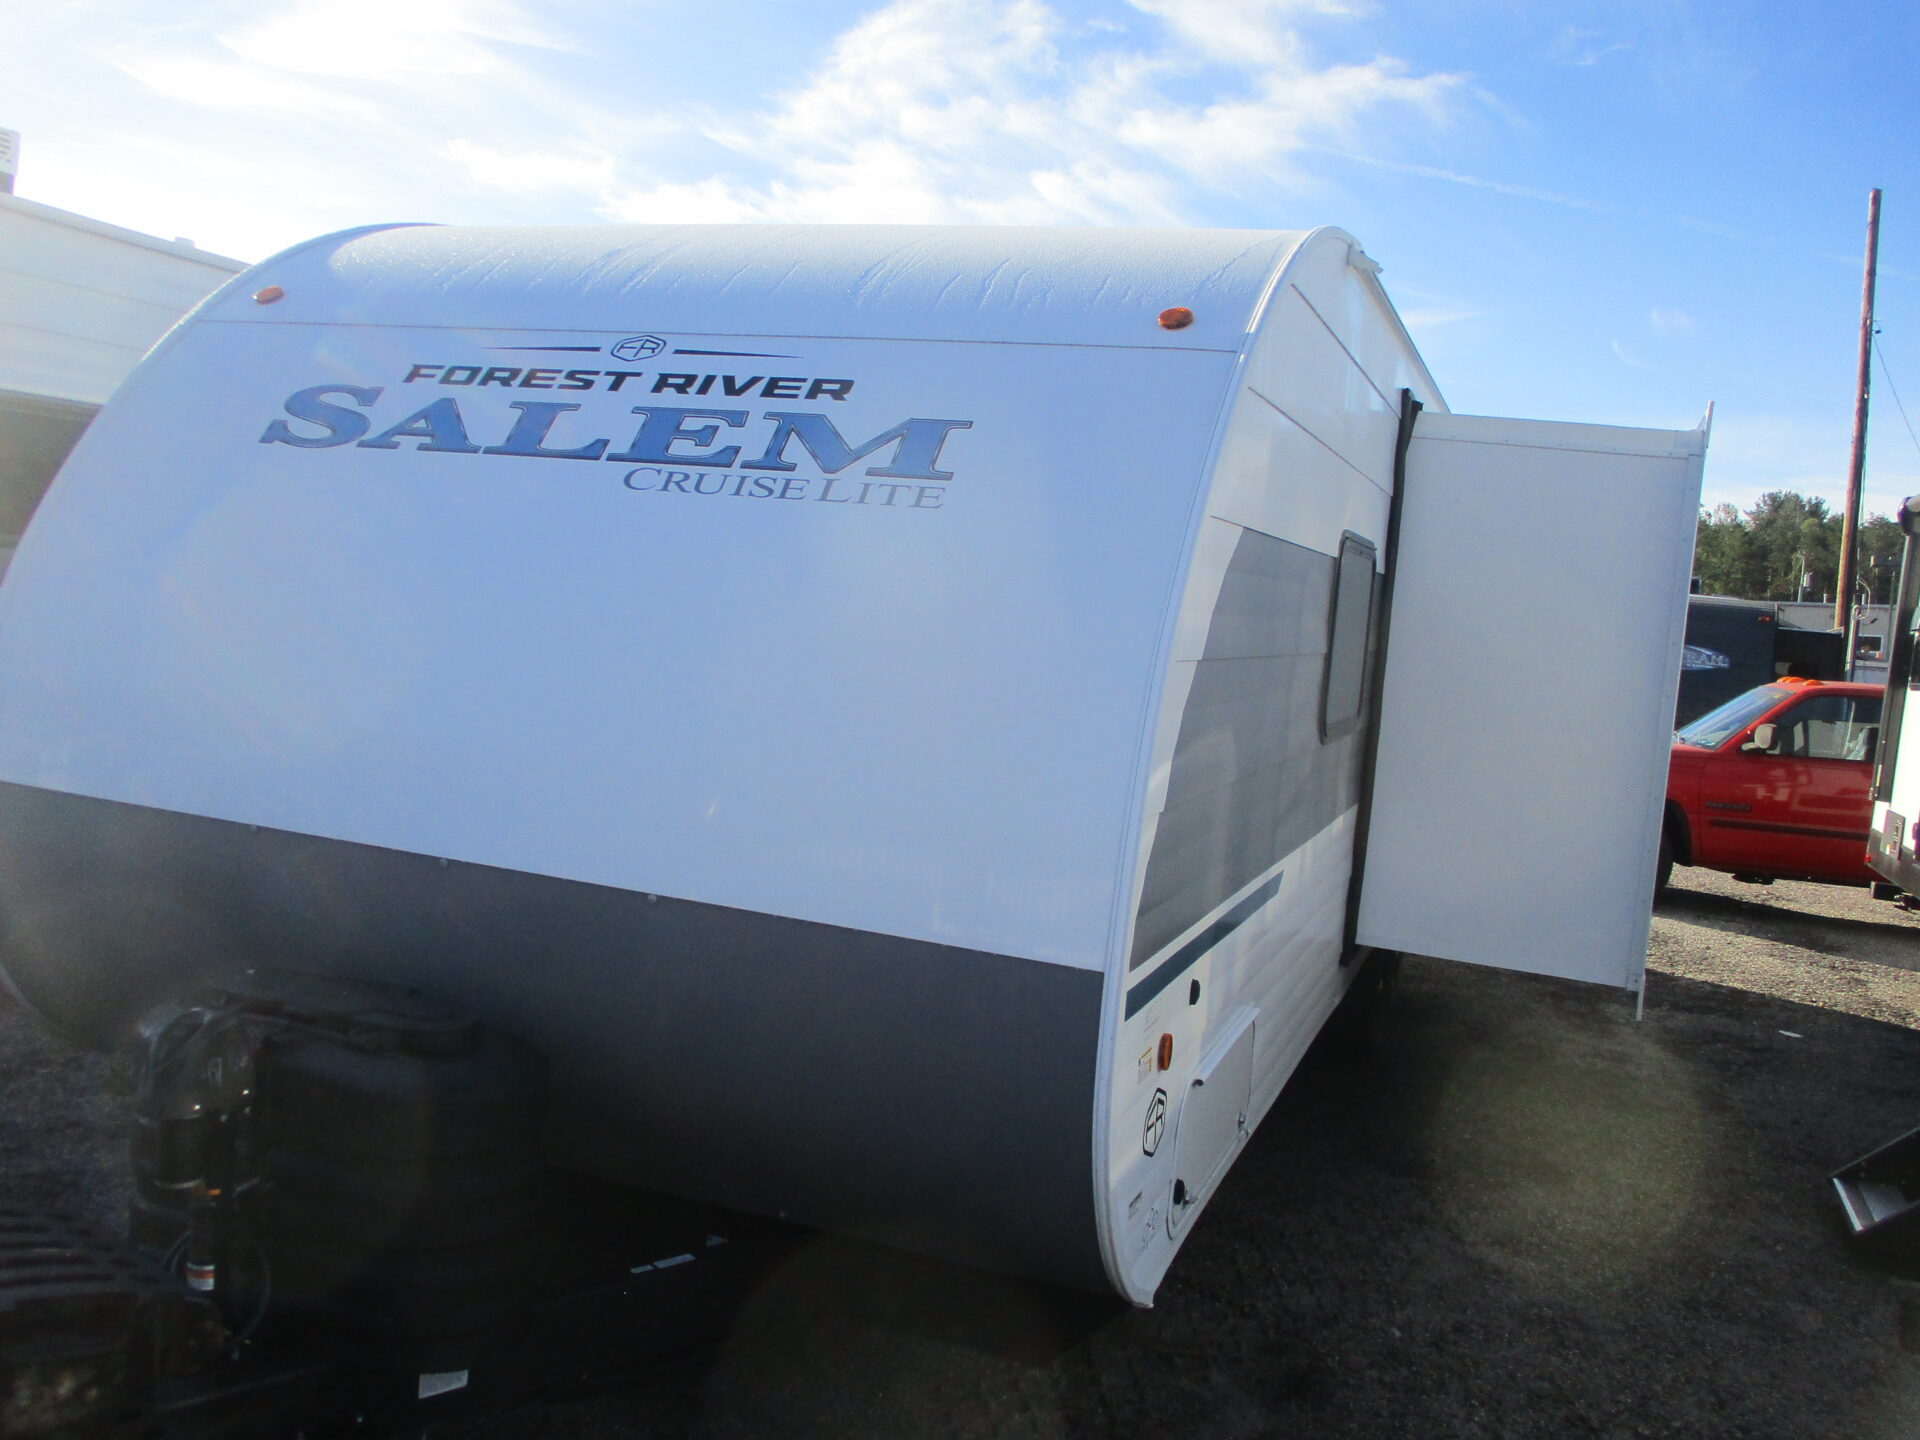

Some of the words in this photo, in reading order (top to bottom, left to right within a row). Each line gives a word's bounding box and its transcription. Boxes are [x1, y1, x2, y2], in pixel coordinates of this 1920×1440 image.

[402, 364, 642, 392] FOREST
[650, 372, 855, 401] RIVER
[259, 384, 973, 481] SALEM
